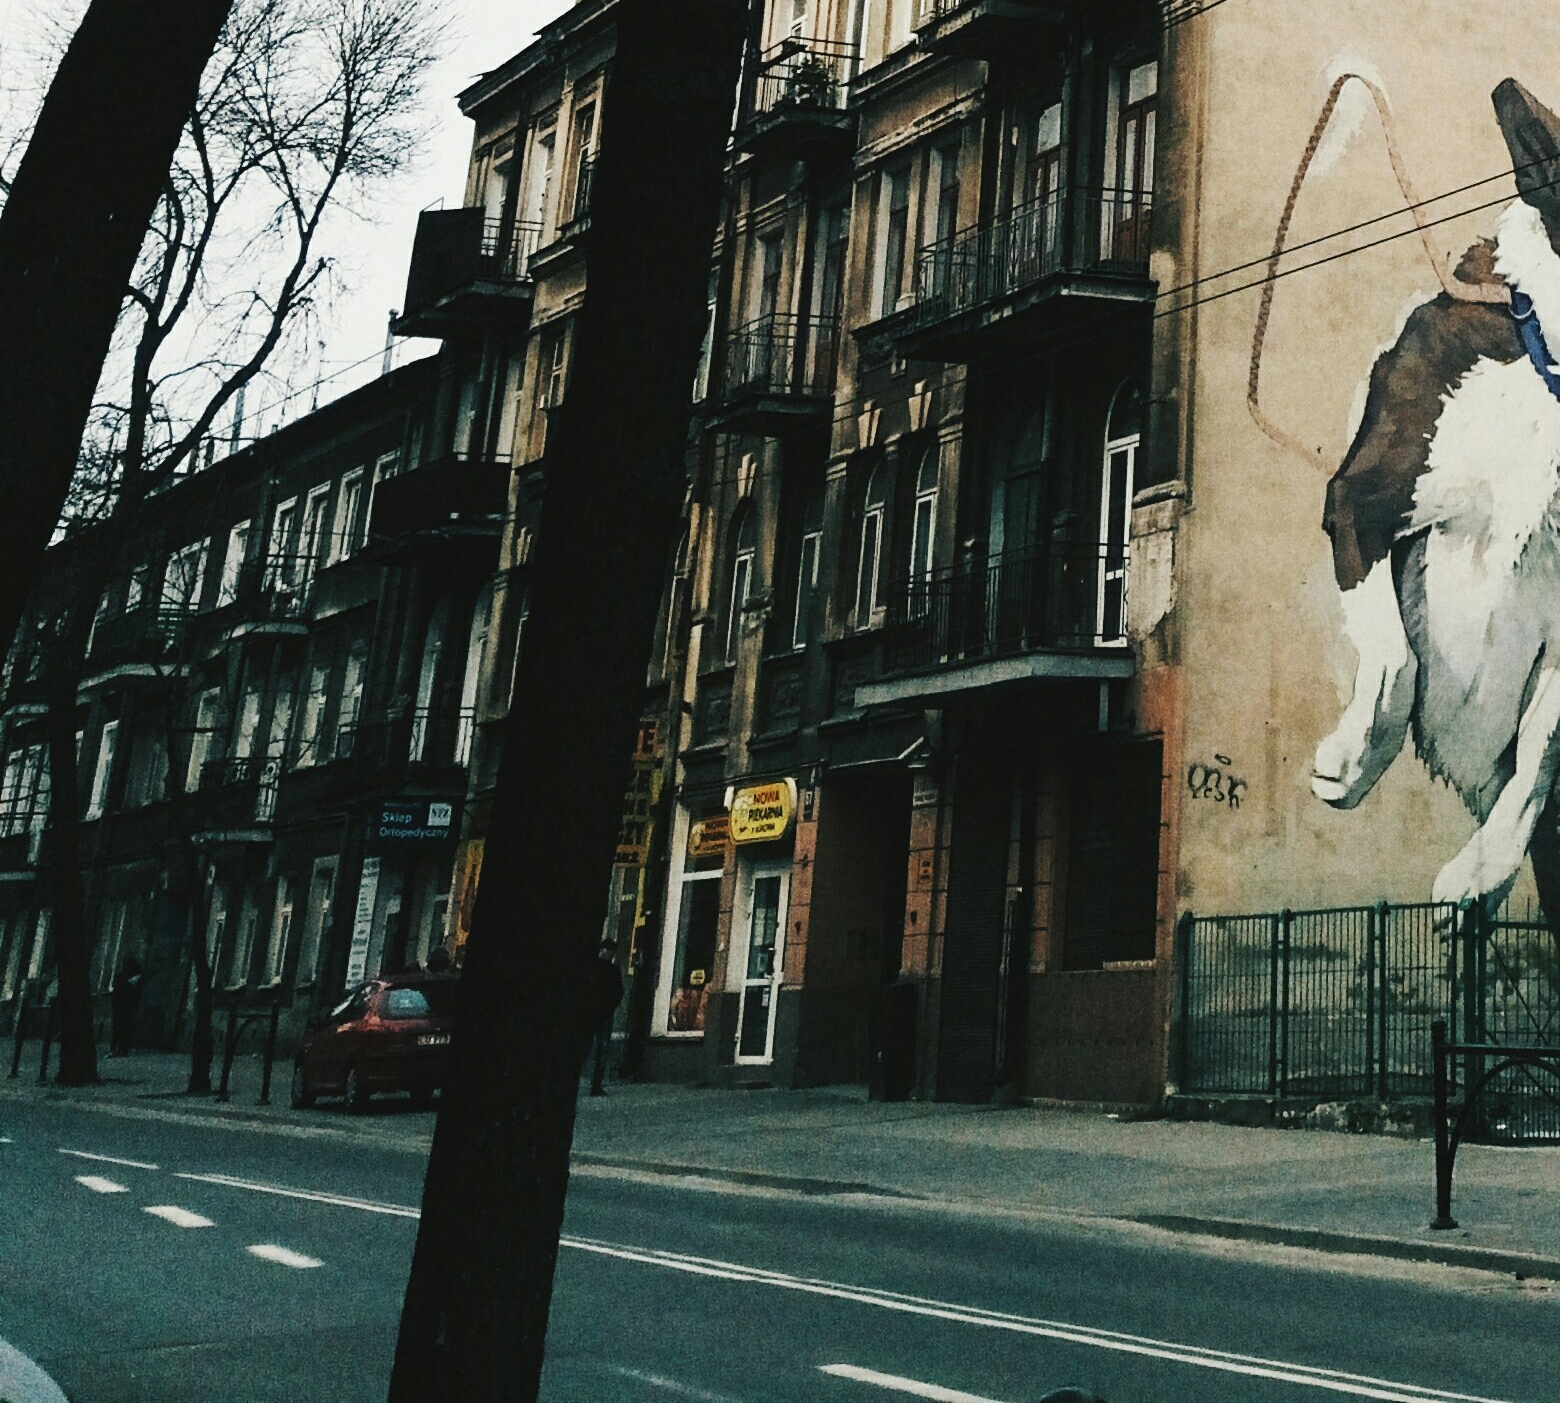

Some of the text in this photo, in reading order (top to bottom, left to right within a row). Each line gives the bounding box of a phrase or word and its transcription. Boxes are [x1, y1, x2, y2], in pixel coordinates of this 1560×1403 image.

[753, 790, 780, 804] NOWA
[382, 811, 412, 824] Sklep
[379, 827, 449, 840] Ortopedyczny
